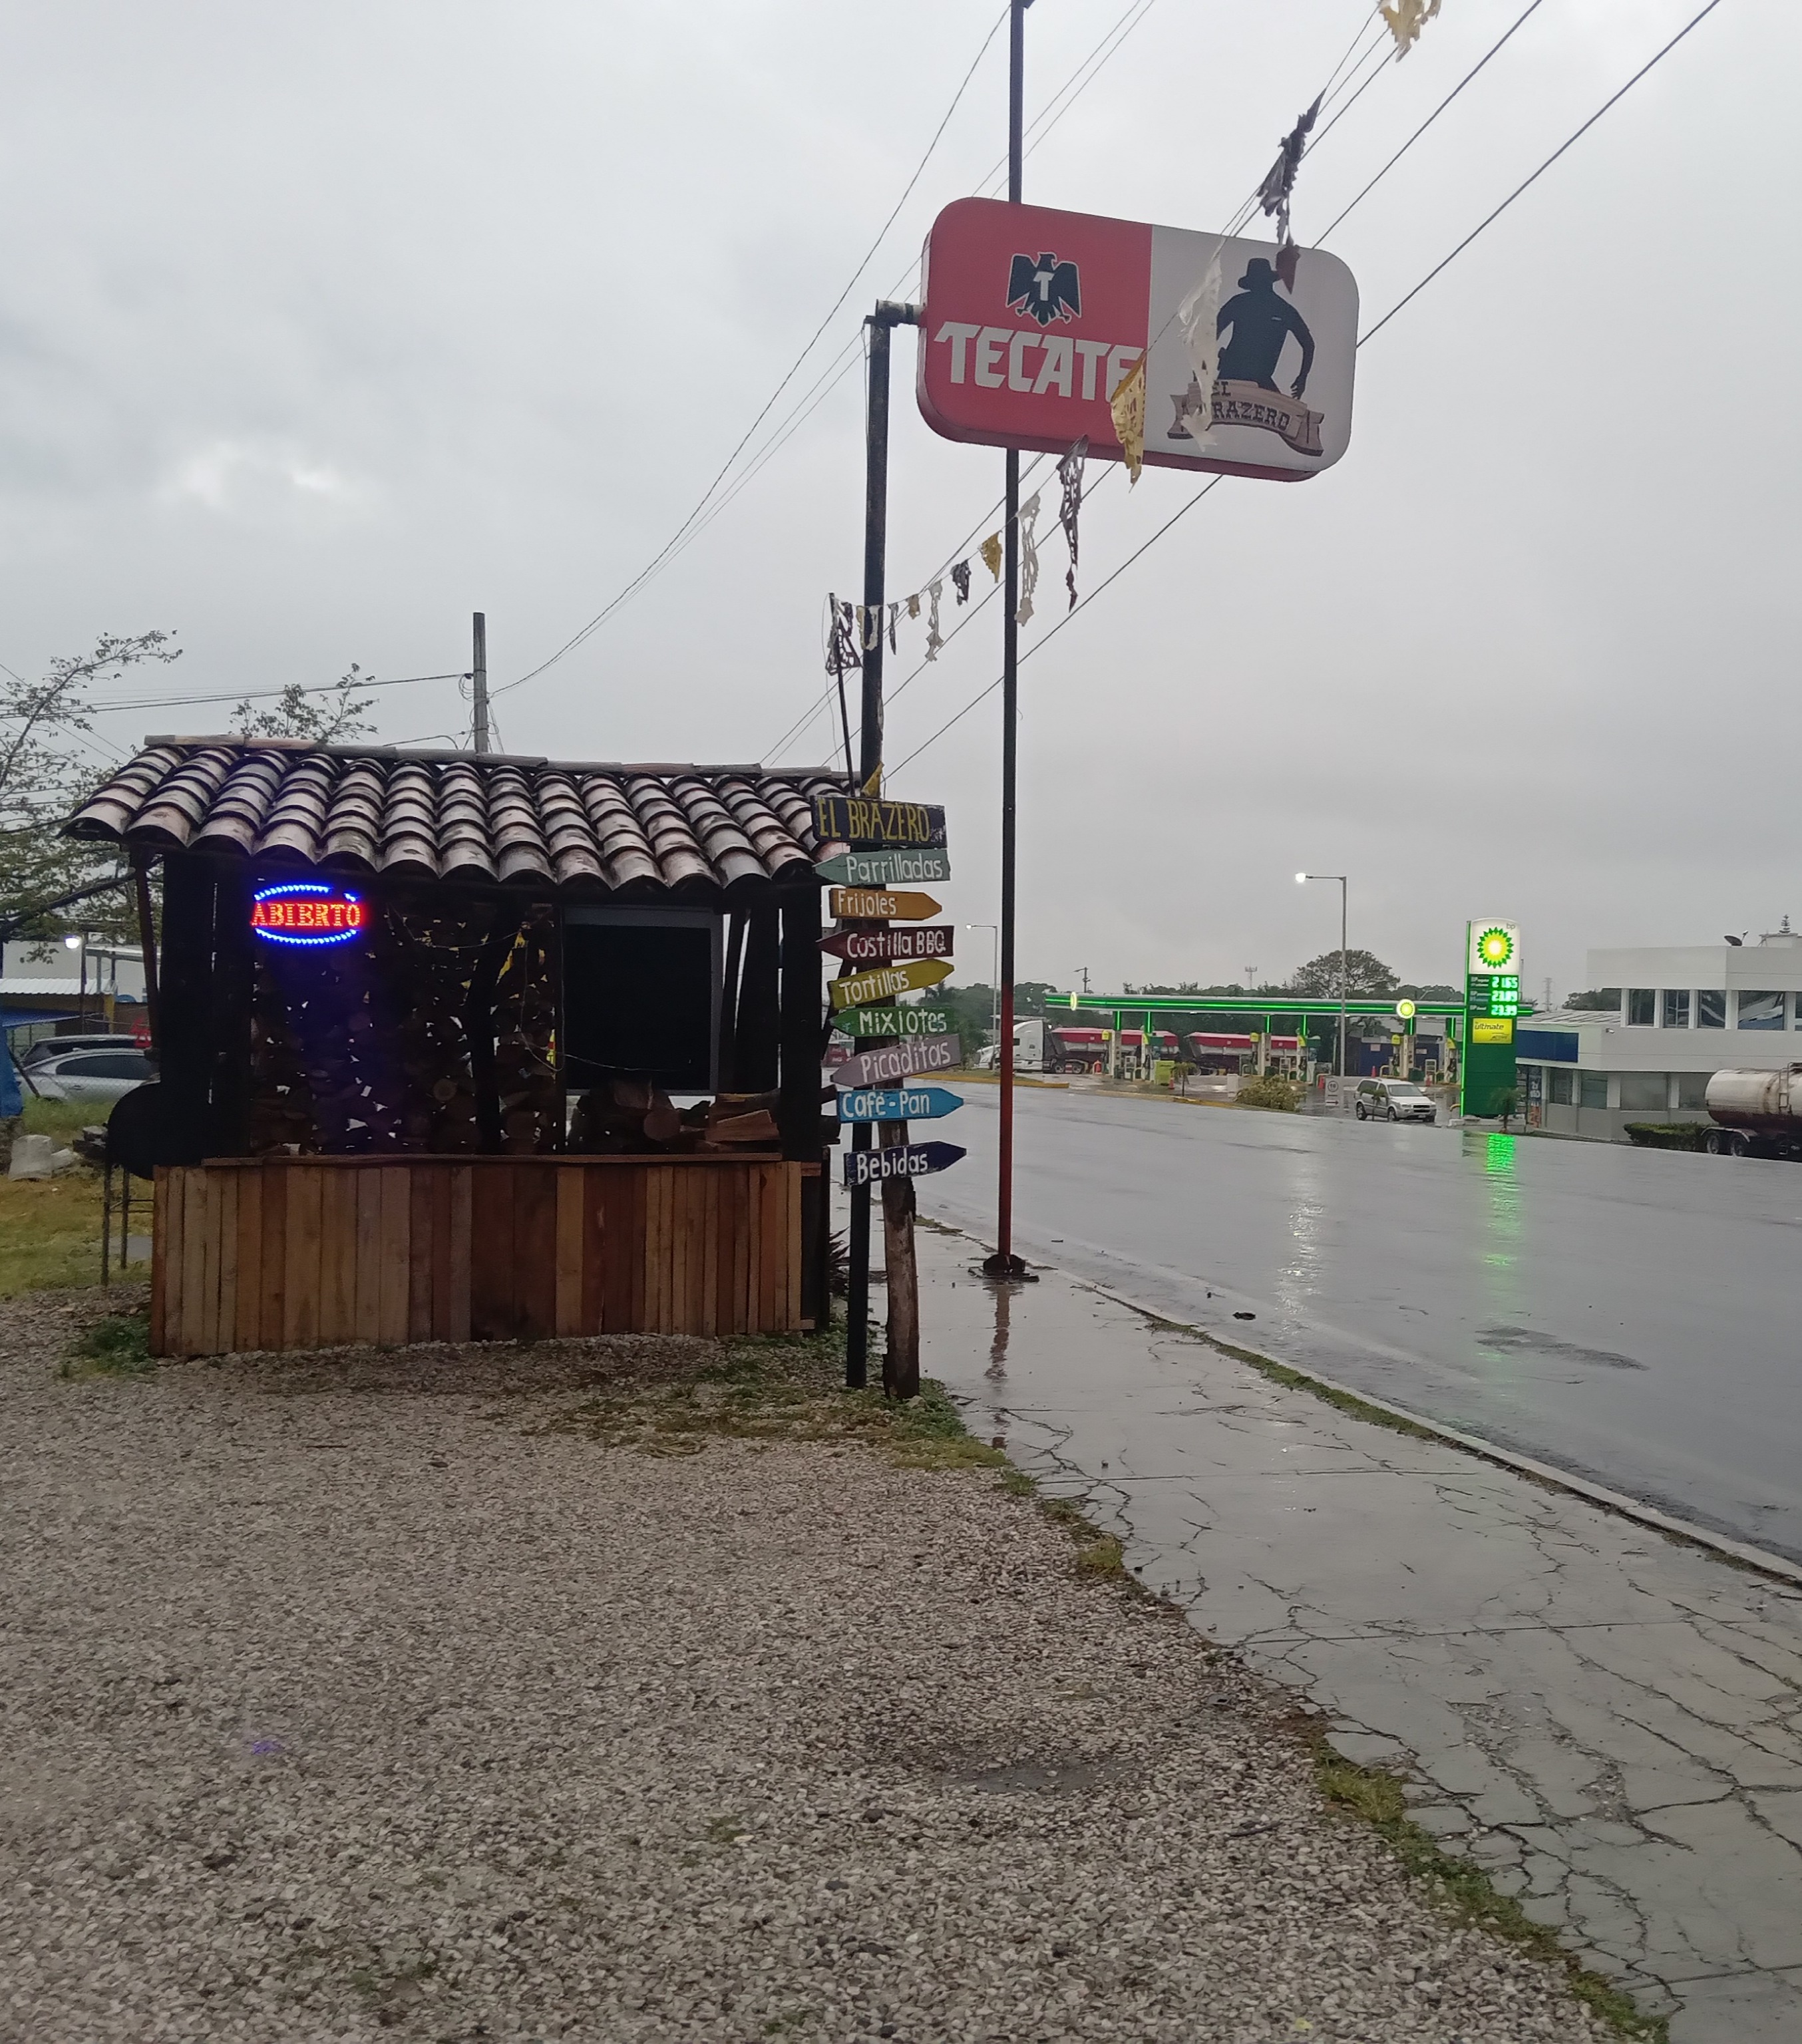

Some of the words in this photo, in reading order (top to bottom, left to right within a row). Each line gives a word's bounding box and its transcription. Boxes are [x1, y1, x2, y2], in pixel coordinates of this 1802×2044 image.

[934, 321, 1144, 403] TECATE
[1197, 401, 1291, 431] RAZERO
[817, 798, 841, 837] EL
[847, 800, 930, 842] BRAZERO
[846, 853, 943, 883] Parrilladas
[250, 903, 360, 927] ABIERTO
[838, 891, 896, 917] Frijoles
[846, 932, 912, 958] Costilla
[916, 930, 947, 955] BBQ
[839, 970, 910, 1005] Tortillas
[860, 1041, 950, 1083] Picaditas
[856, 1148, 928, 1183] Bebidas
